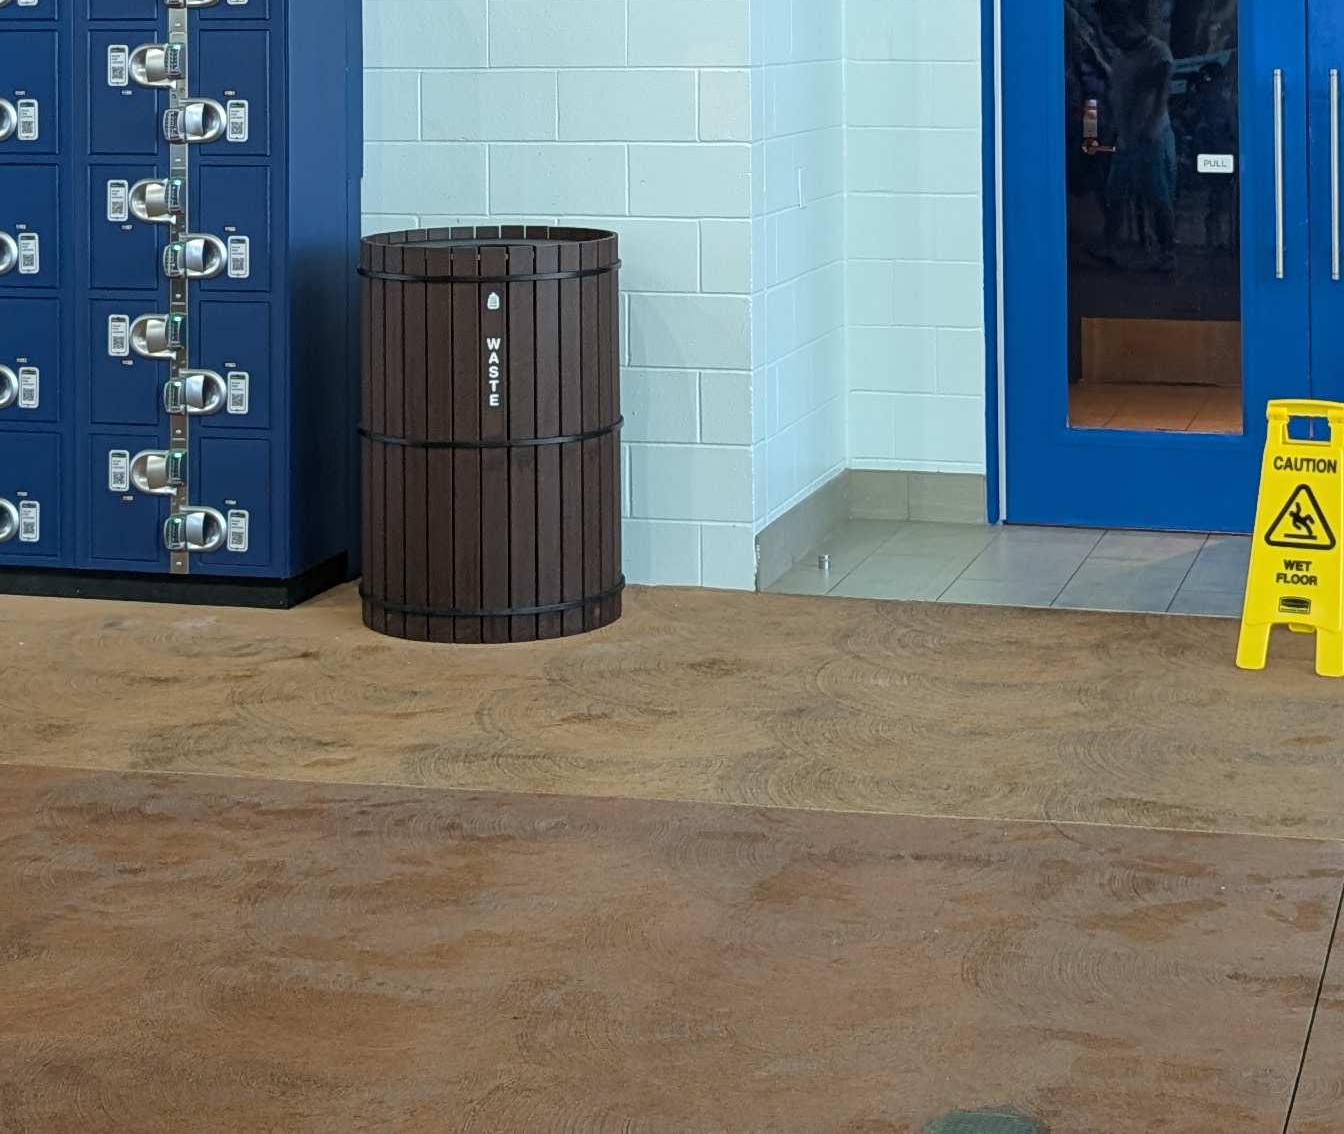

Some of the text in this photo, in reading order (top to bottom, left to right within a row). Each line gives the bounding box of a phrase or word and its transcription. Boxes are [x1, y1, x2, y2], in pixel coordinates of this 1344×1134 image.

[1203, 159, 1227, 168] PULL
[486, 337, 501, 407] WASTE
[1273, 456, 1337, 474] CAUTION
[1283, 559, 1312, 572] WET
[1275, 573, 1318, 586] FLOOR
